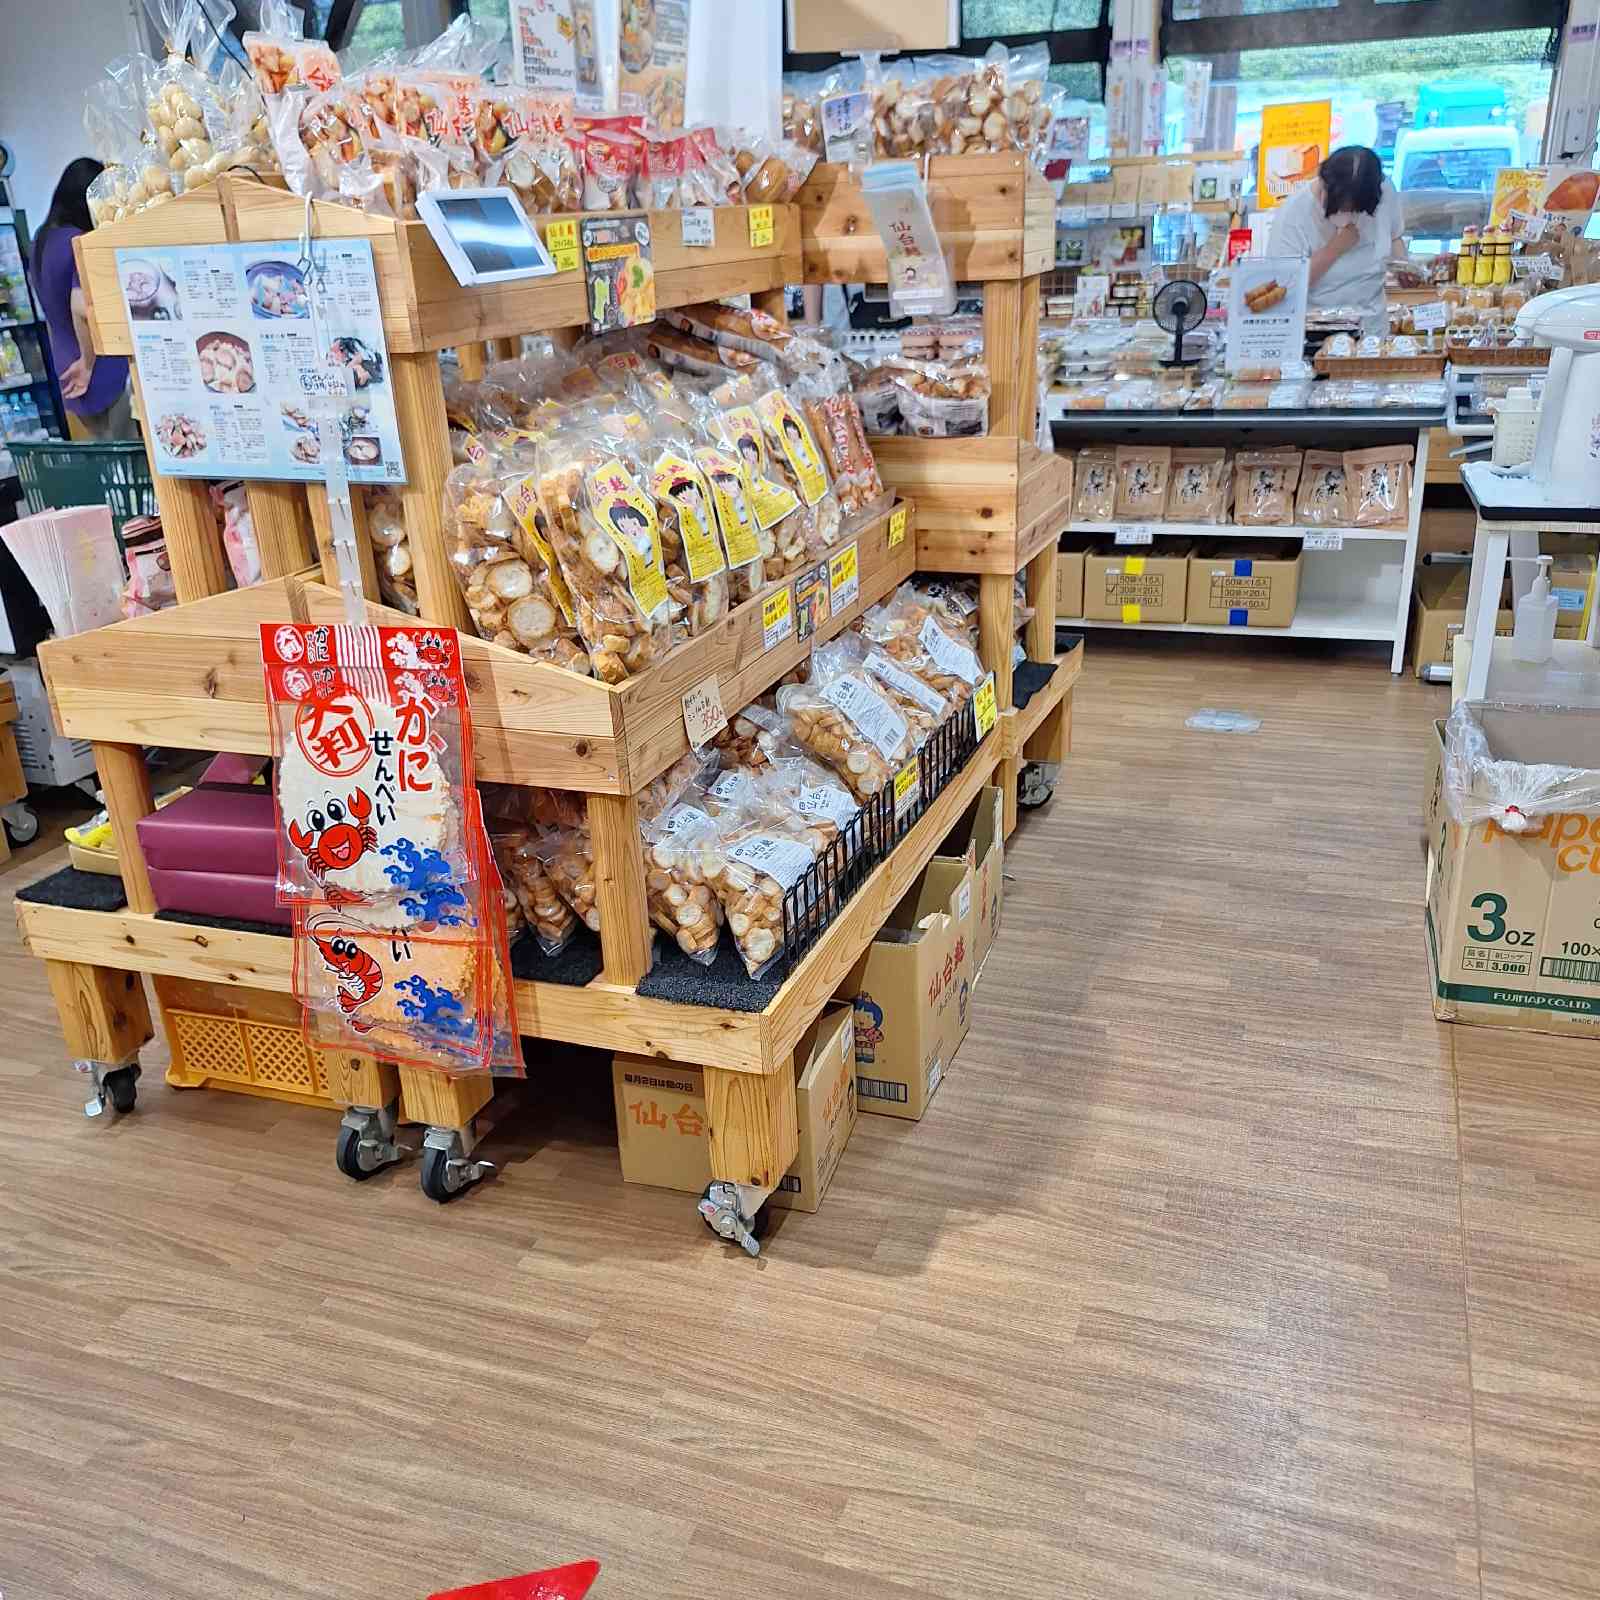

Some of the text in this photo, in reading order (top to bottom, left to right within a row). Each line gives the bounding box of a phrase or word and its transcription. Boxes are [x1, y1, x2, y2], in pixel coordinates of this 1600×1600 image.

[300, 692, 369, 769] 大判
[395, 696, 440, 792] かに
[369, 730, 396, 826] せんべい
[1467, 892, 1509, 943] 3
[628, 1101, 704, 1137] 仙台
